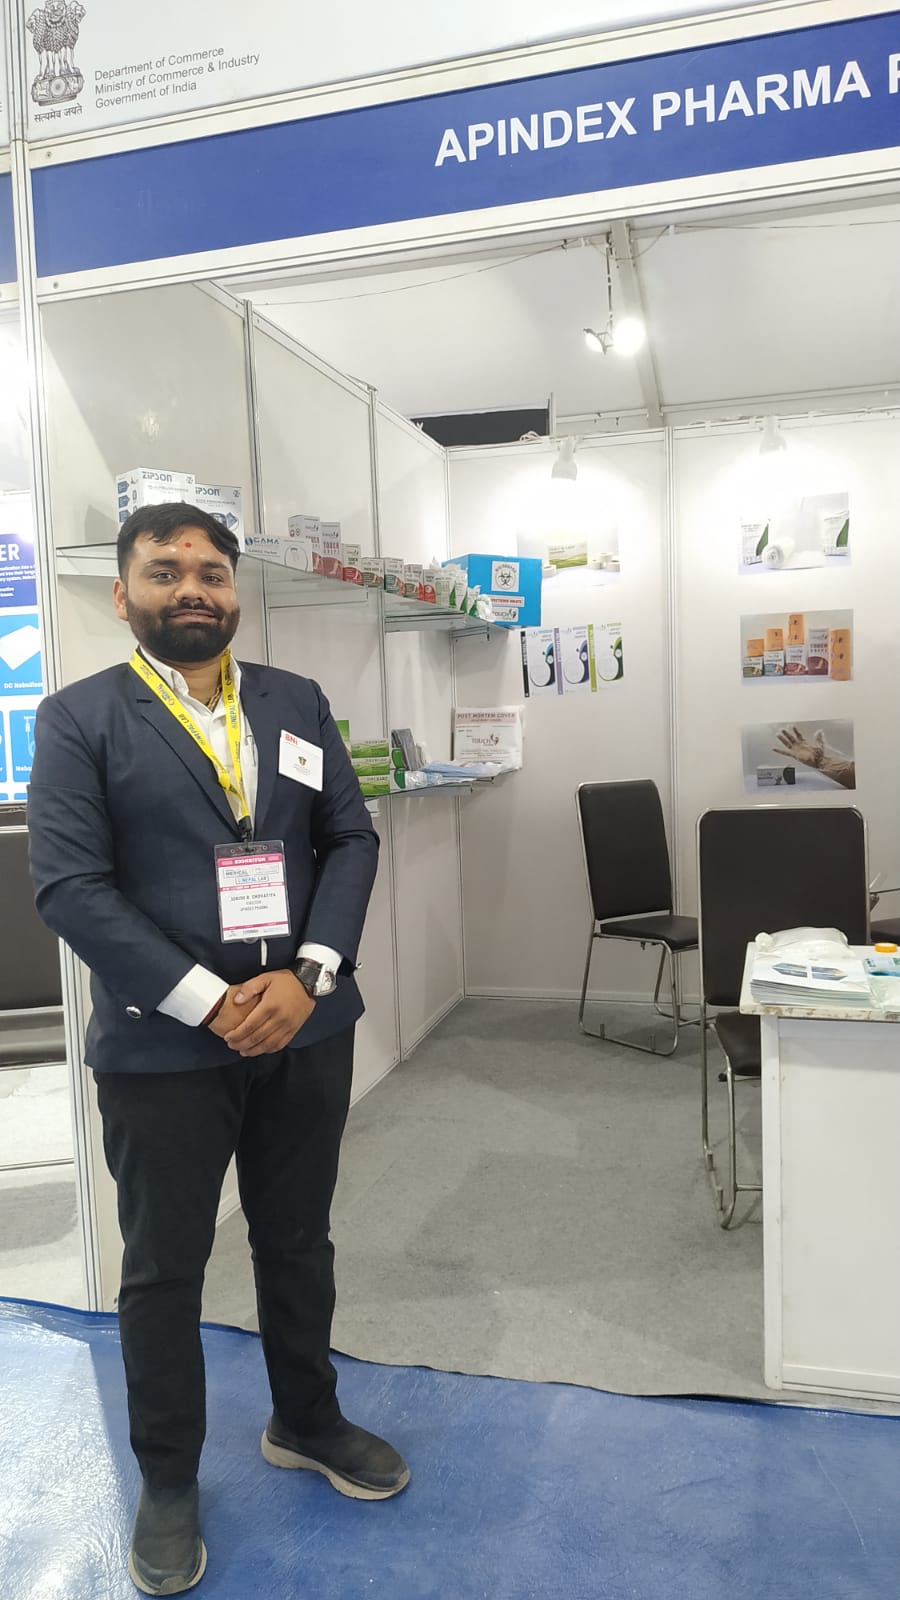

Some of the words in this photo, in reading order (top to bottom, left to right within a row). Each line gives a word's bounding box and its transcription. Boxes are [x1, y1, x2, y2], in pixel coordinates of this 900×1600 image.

[94, 60, 153, 81] Department
[156, 57, 166, 68] of
[168, 47, 224, 66] Commerce
[95, 76, 133, 95] Ministry
[136, 76, 146, 86] of
[148, 65, 204, 84] Commerce
[208, 62, 215, 72] &
[218, 53, 260, 71] Industry
[96, 89, 156, 109] Government
[160, 86, 170, 96] of
[172, 81, 197, 94] India
[434, 98, 637, 168] APINDEX
[652, 60, 871, 132] PHARMA
